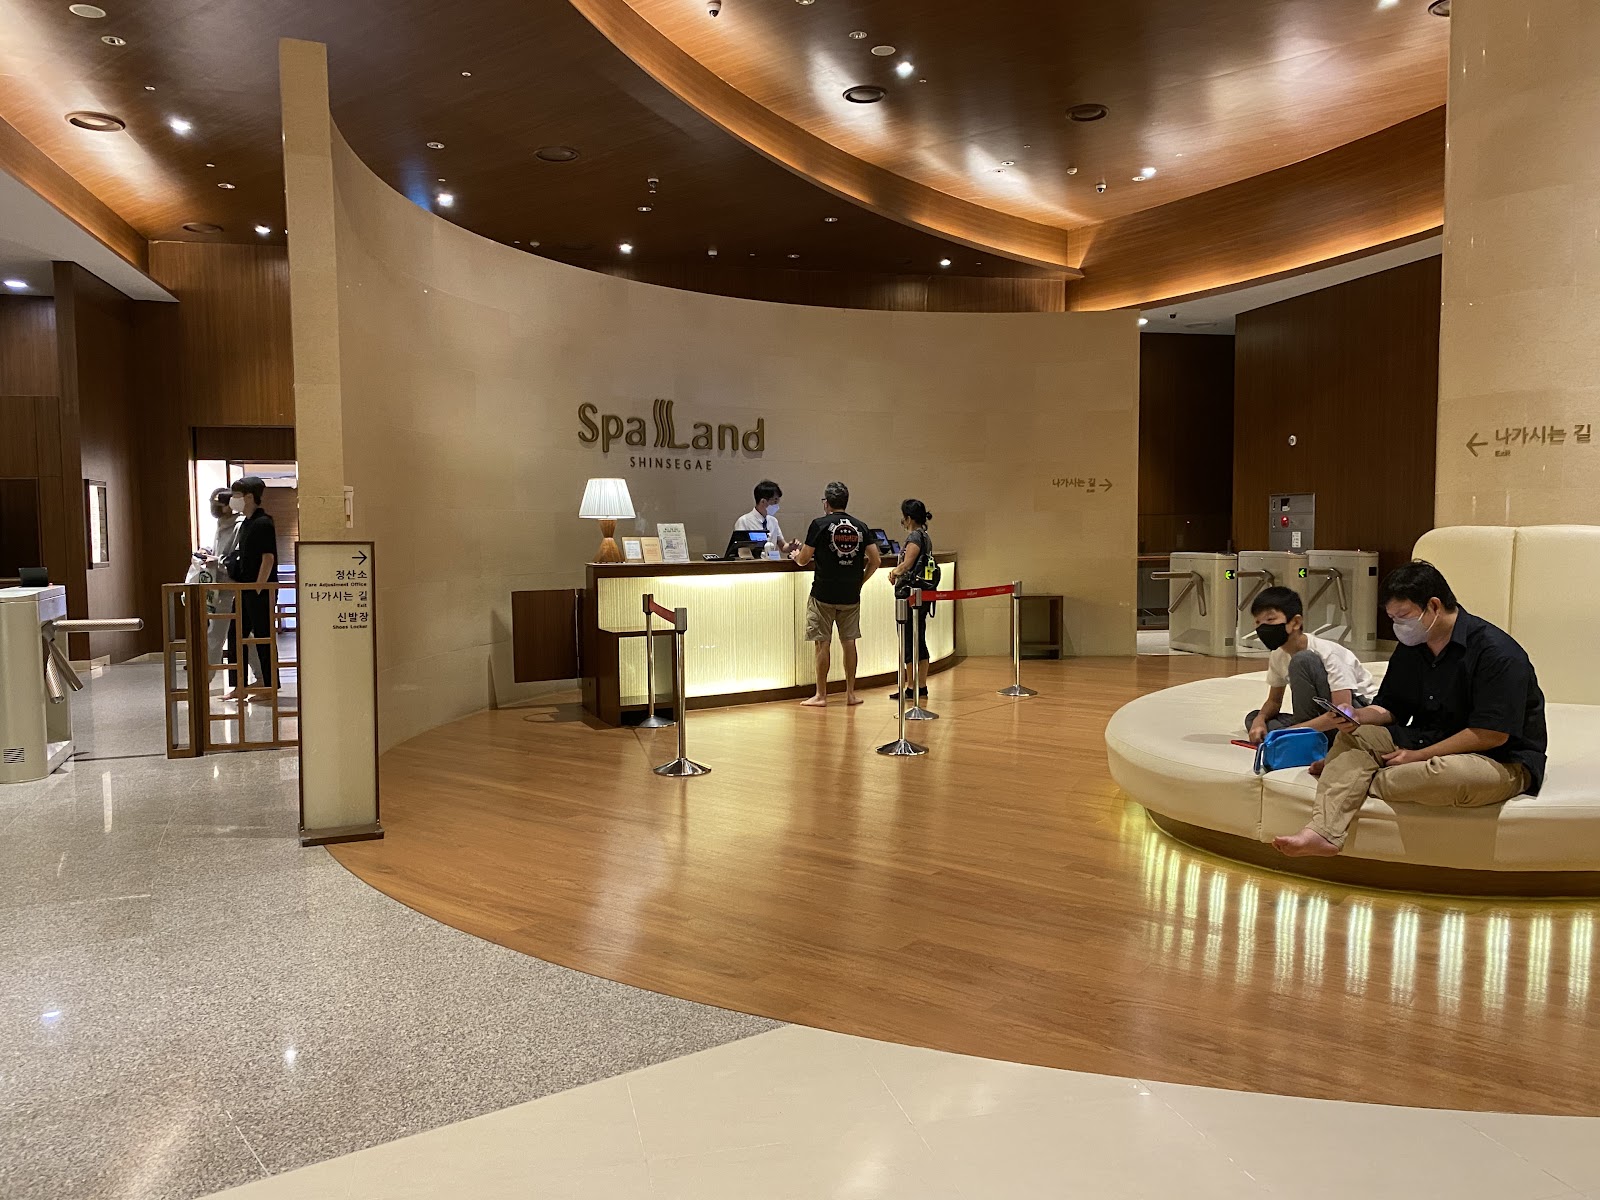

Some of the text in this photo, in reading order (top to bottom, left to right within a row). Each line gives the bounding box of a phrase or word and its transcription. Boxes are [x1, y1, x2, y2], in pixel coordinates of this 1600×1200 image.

[578, 399, 765, 453] Spa Land
[1495, 423, 1591, 445] 나가시는 길
[630, 456, 712, 470] SHINSEGAE
[1052, 477, 1096, 488] 나가시는 길
[335, 570, 368, 580] 정산소
[310, 591, 368, 601] 나가시는 길
[337, 612, 369, 623] 신발장
